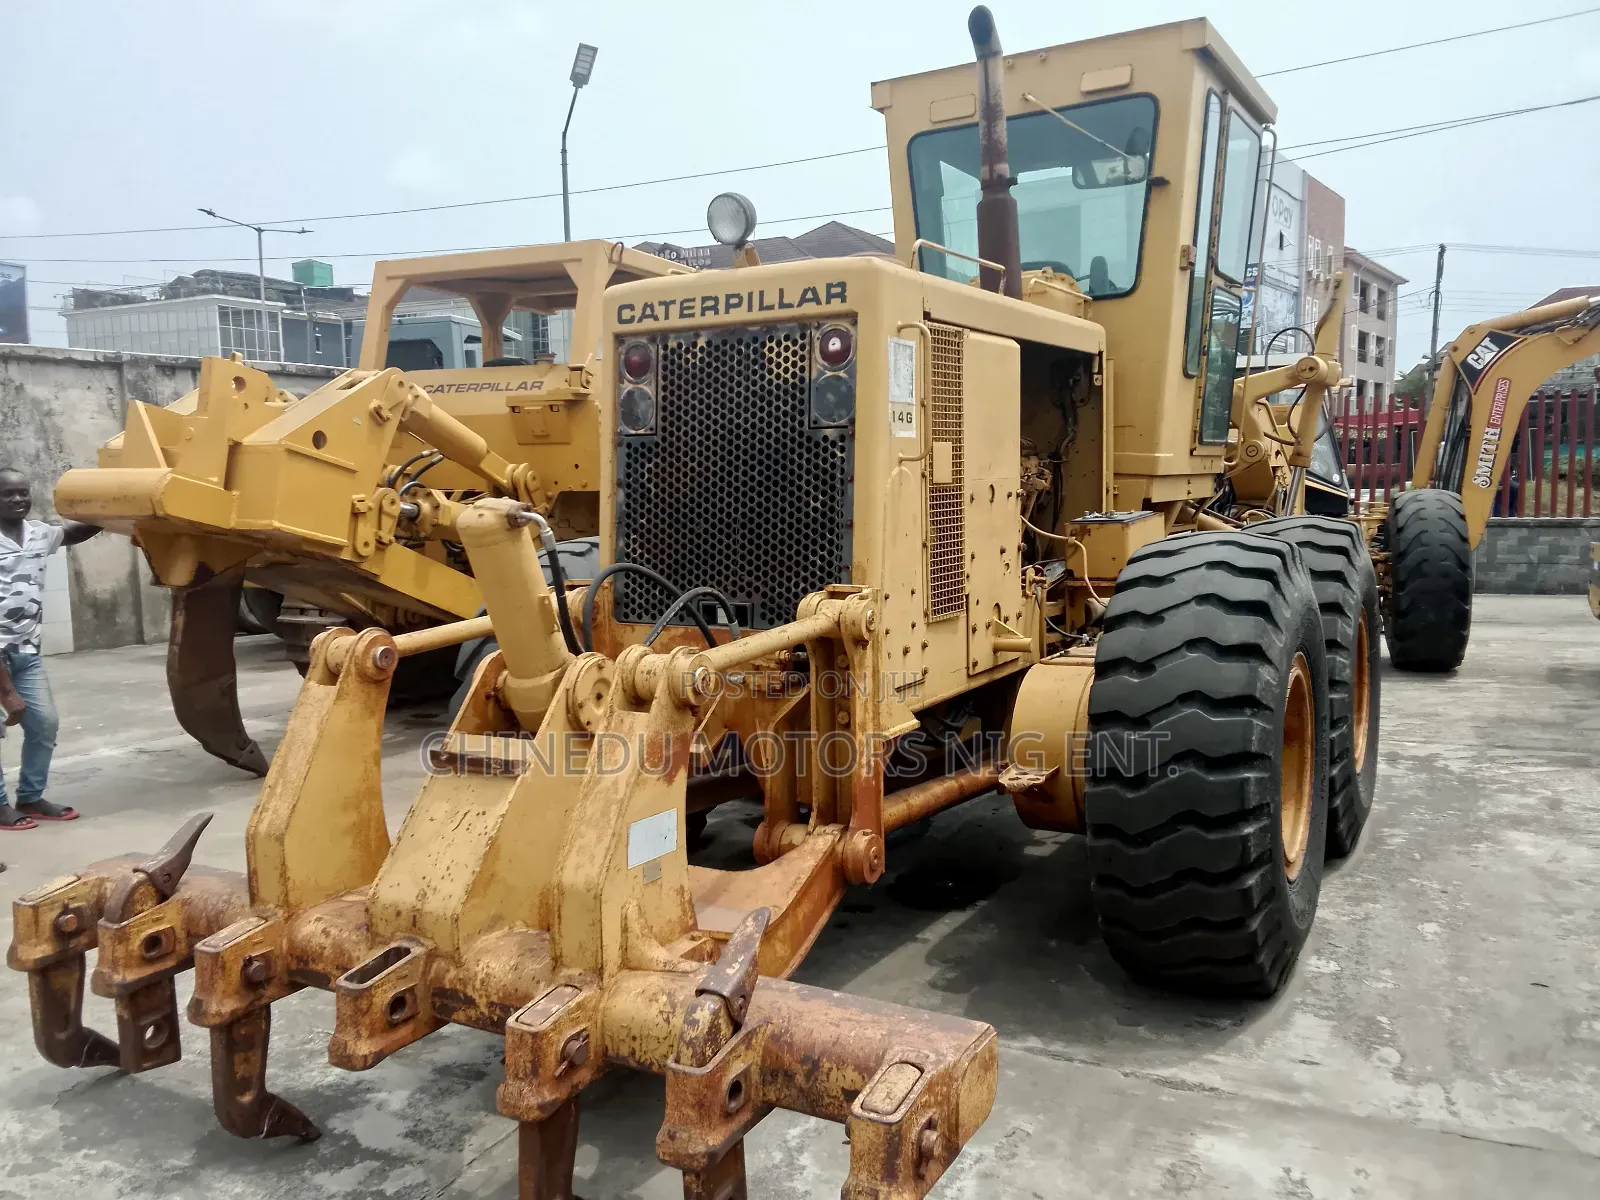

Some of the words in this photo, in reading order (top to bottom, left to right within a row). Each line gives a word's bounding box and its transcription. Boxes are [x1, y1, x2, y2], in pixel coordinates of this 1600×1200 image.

[617, 281, 848, 326] CATERPILLAR
[1466, 336, 1501, 370] CAT
[422, 380, 545, 395] CATERPILLAR
[892, 410, 913, 424] 14G
[1472, 424, 1501, 489] SMITH
[1489, 378, 1511, 425] ENTERPRISES
